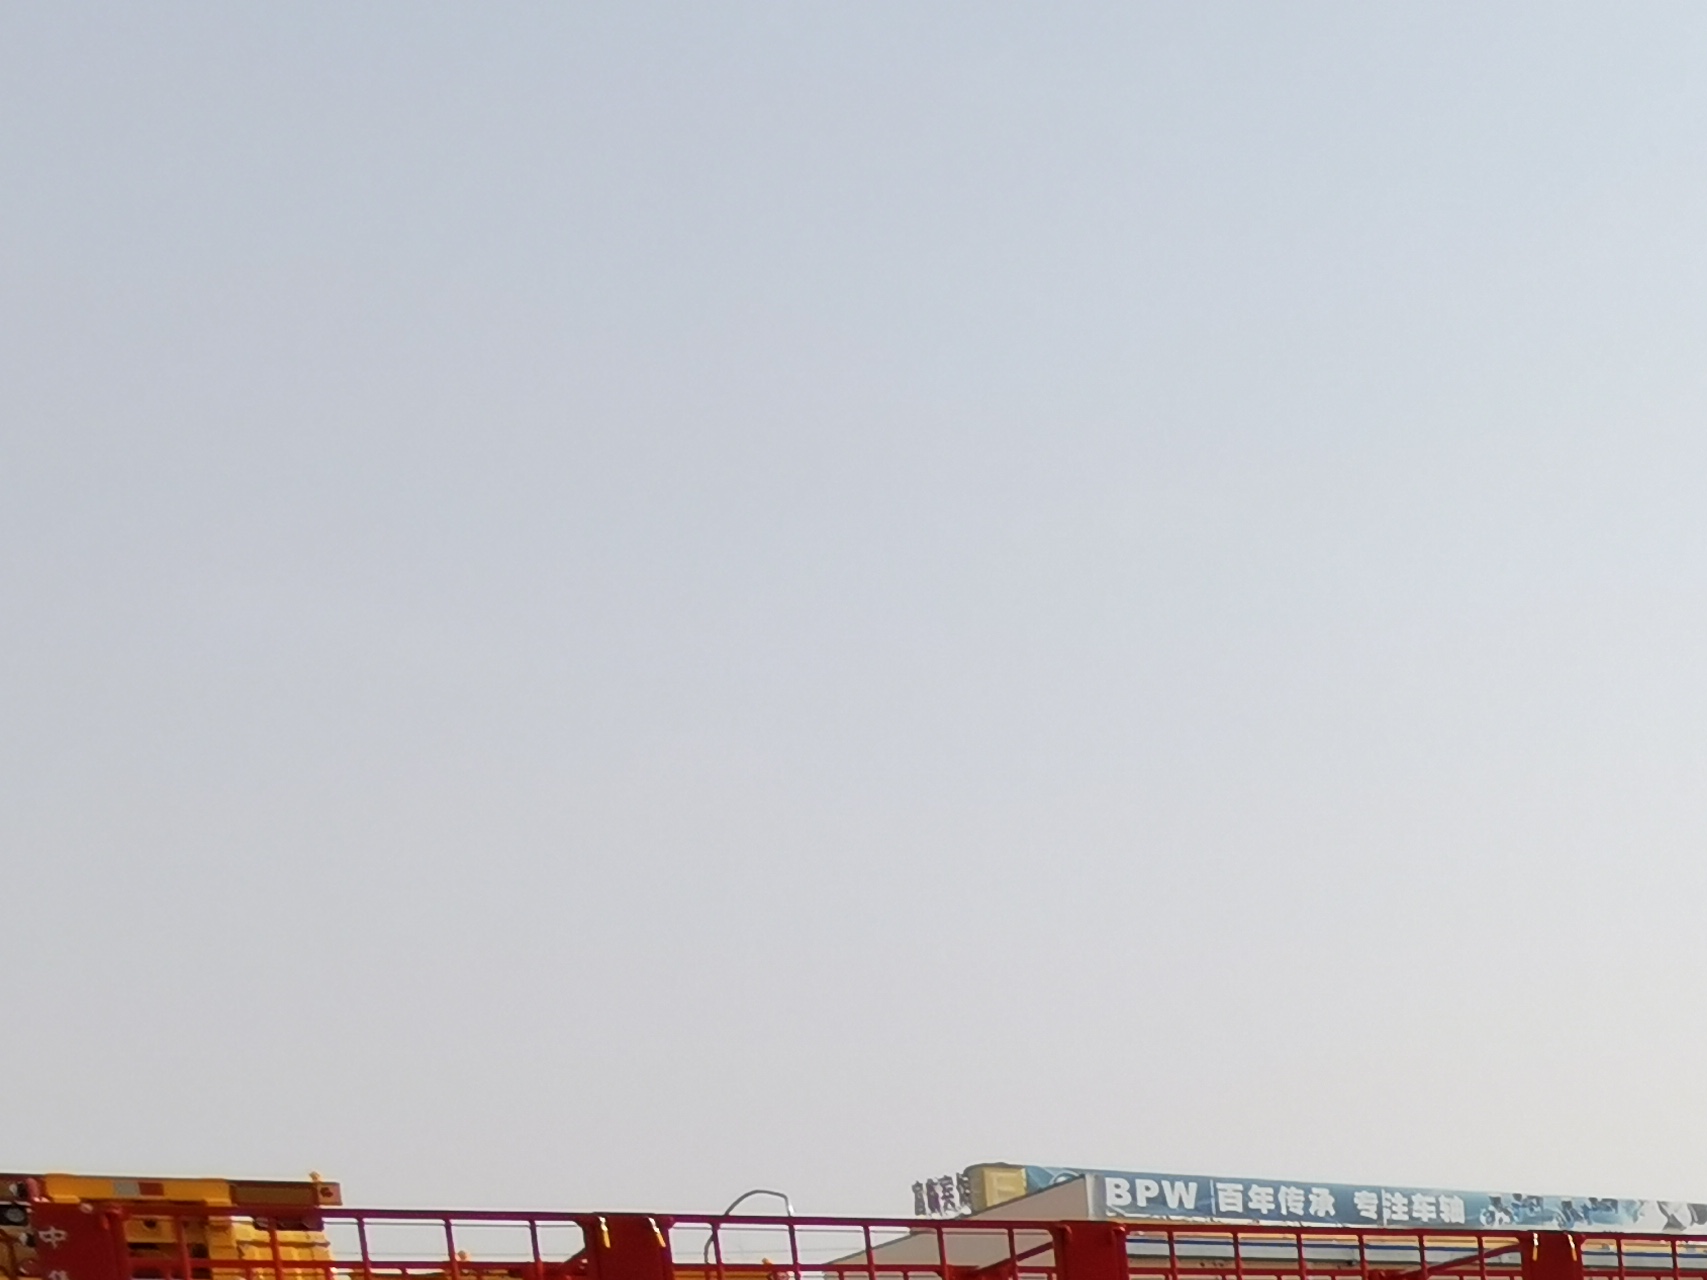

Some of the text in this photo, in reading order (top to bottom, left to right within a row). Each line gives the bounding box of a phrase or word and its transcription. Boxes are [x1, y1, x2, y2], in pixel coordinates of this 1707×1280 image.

[1104, 1177, 1466, 1224] BPW 百年传承 专注车轴
